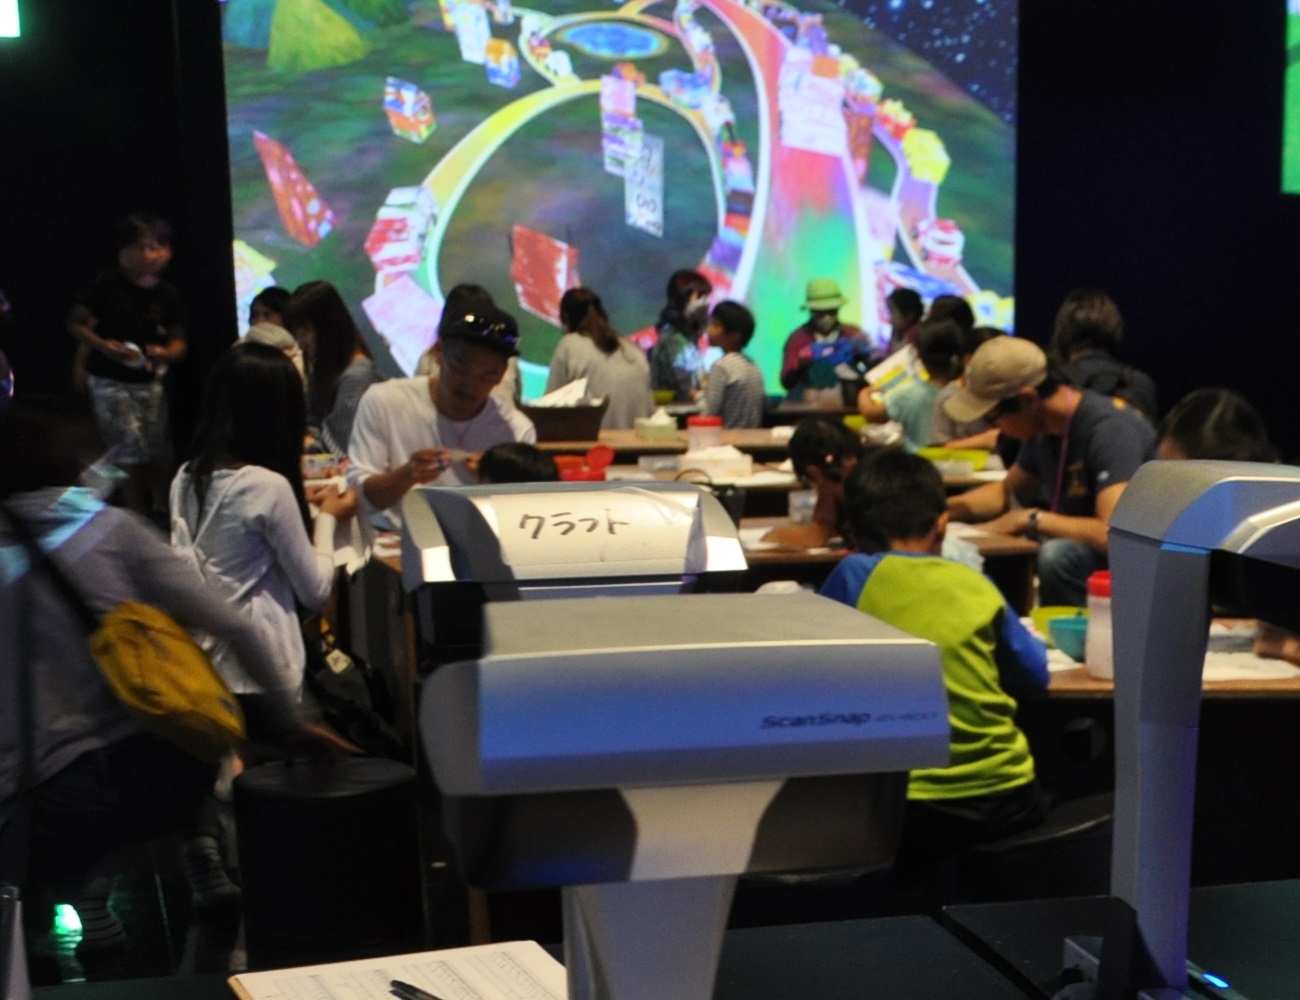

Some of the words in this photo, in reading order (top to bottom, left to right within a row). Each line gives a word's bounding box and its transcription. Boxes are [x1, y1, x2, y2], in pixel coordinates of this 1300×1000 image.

[518, 508, 630, 540] クラフト
[760, 712, 872, 729] ScanSnap
